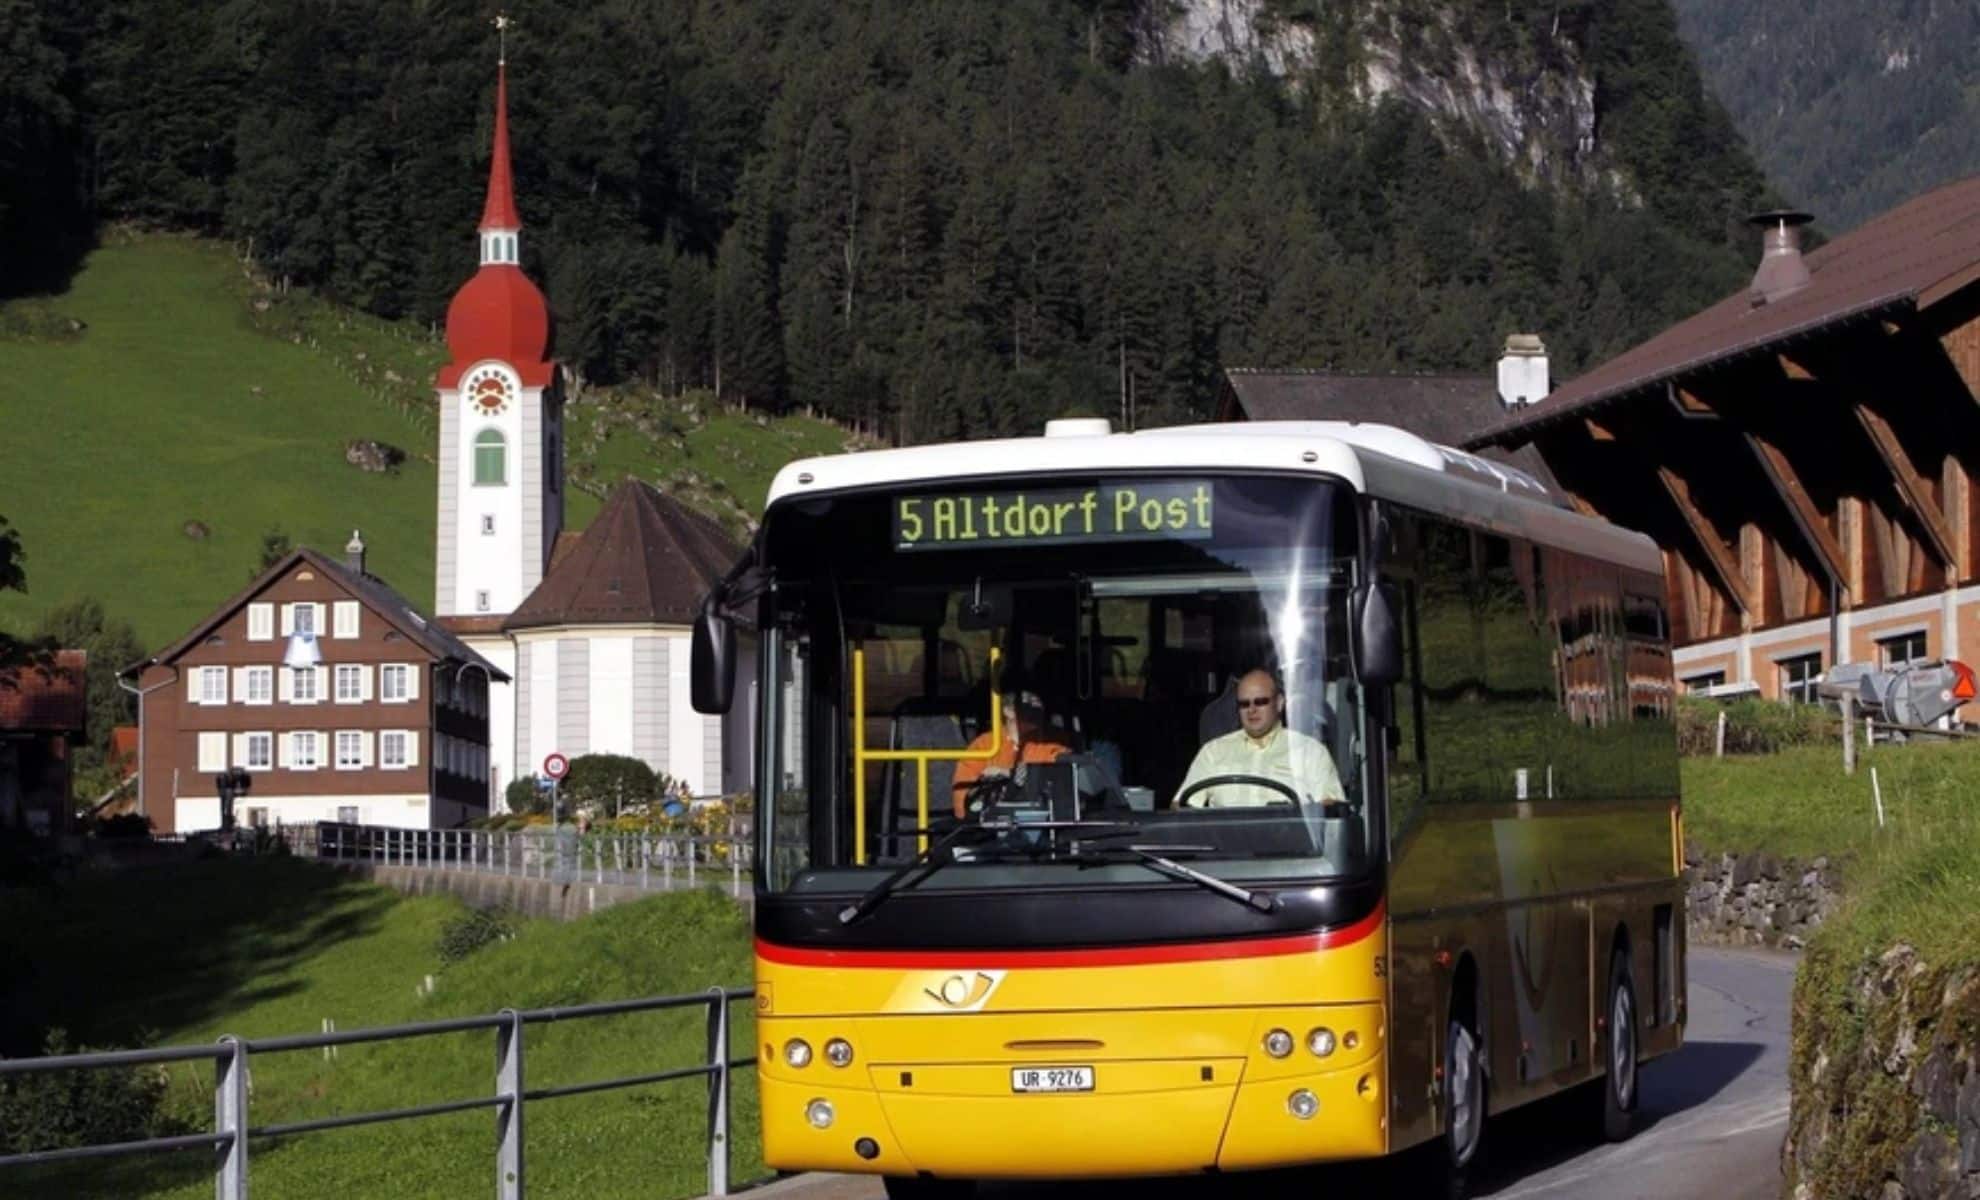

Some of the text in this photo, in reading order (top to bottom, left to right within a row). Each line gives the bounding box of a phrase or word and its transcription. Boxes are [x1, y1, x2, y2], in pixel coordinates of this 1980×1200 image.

[901, 486, 1211, 541] 5 Altdorf Post
[1021, 1069, 1084, 1087] UR 9276
